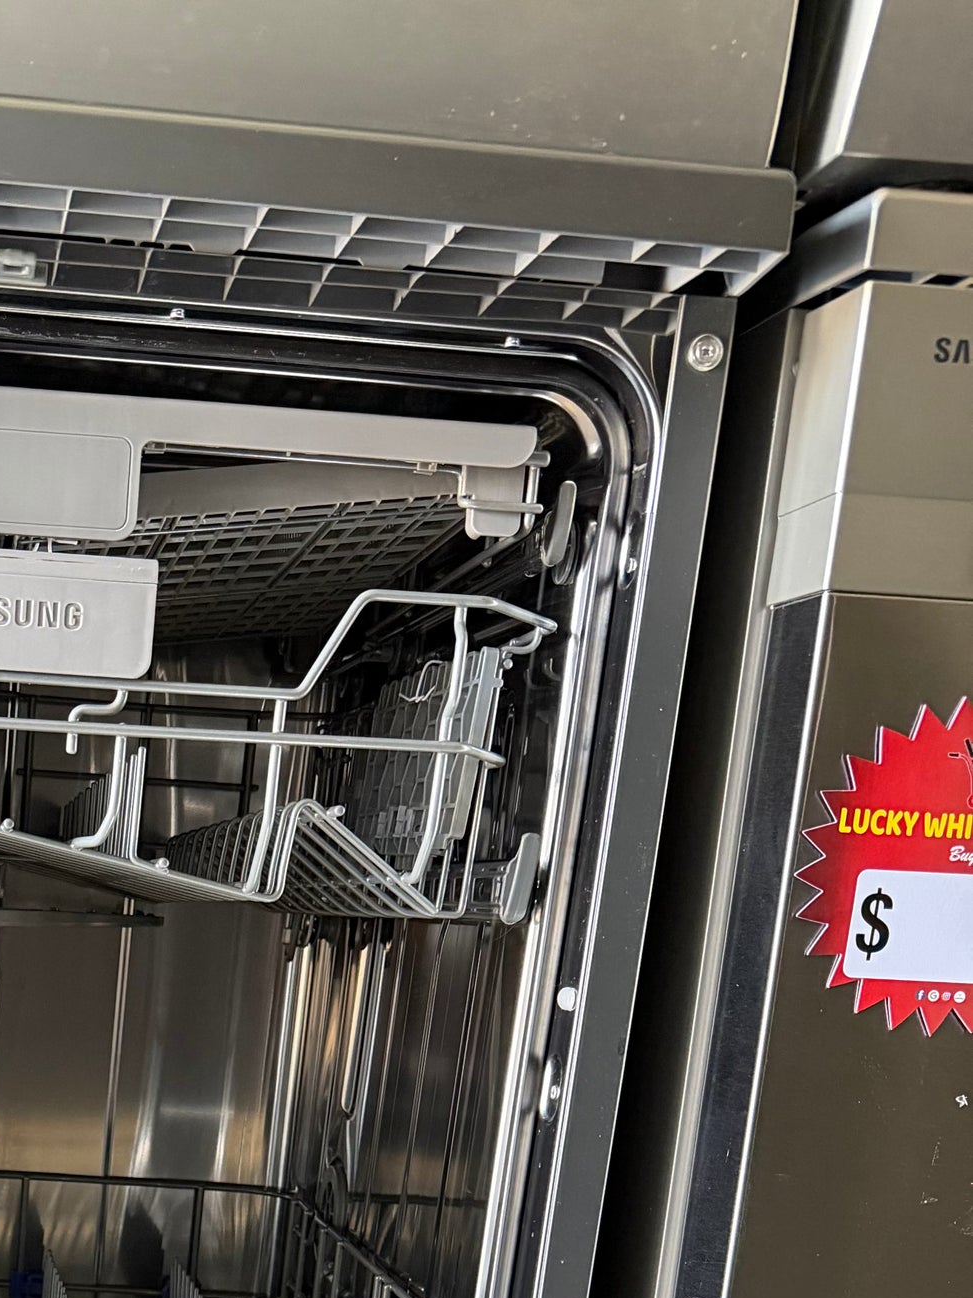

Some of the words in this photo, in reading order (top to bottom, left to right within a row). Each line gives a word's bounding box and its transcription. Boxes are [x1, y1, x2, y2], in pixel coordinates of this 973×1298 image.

[838, 807, 920, 837] LUCKY
[924, 811, 973, 840] WHI
[855, 887, 894, 961] $
